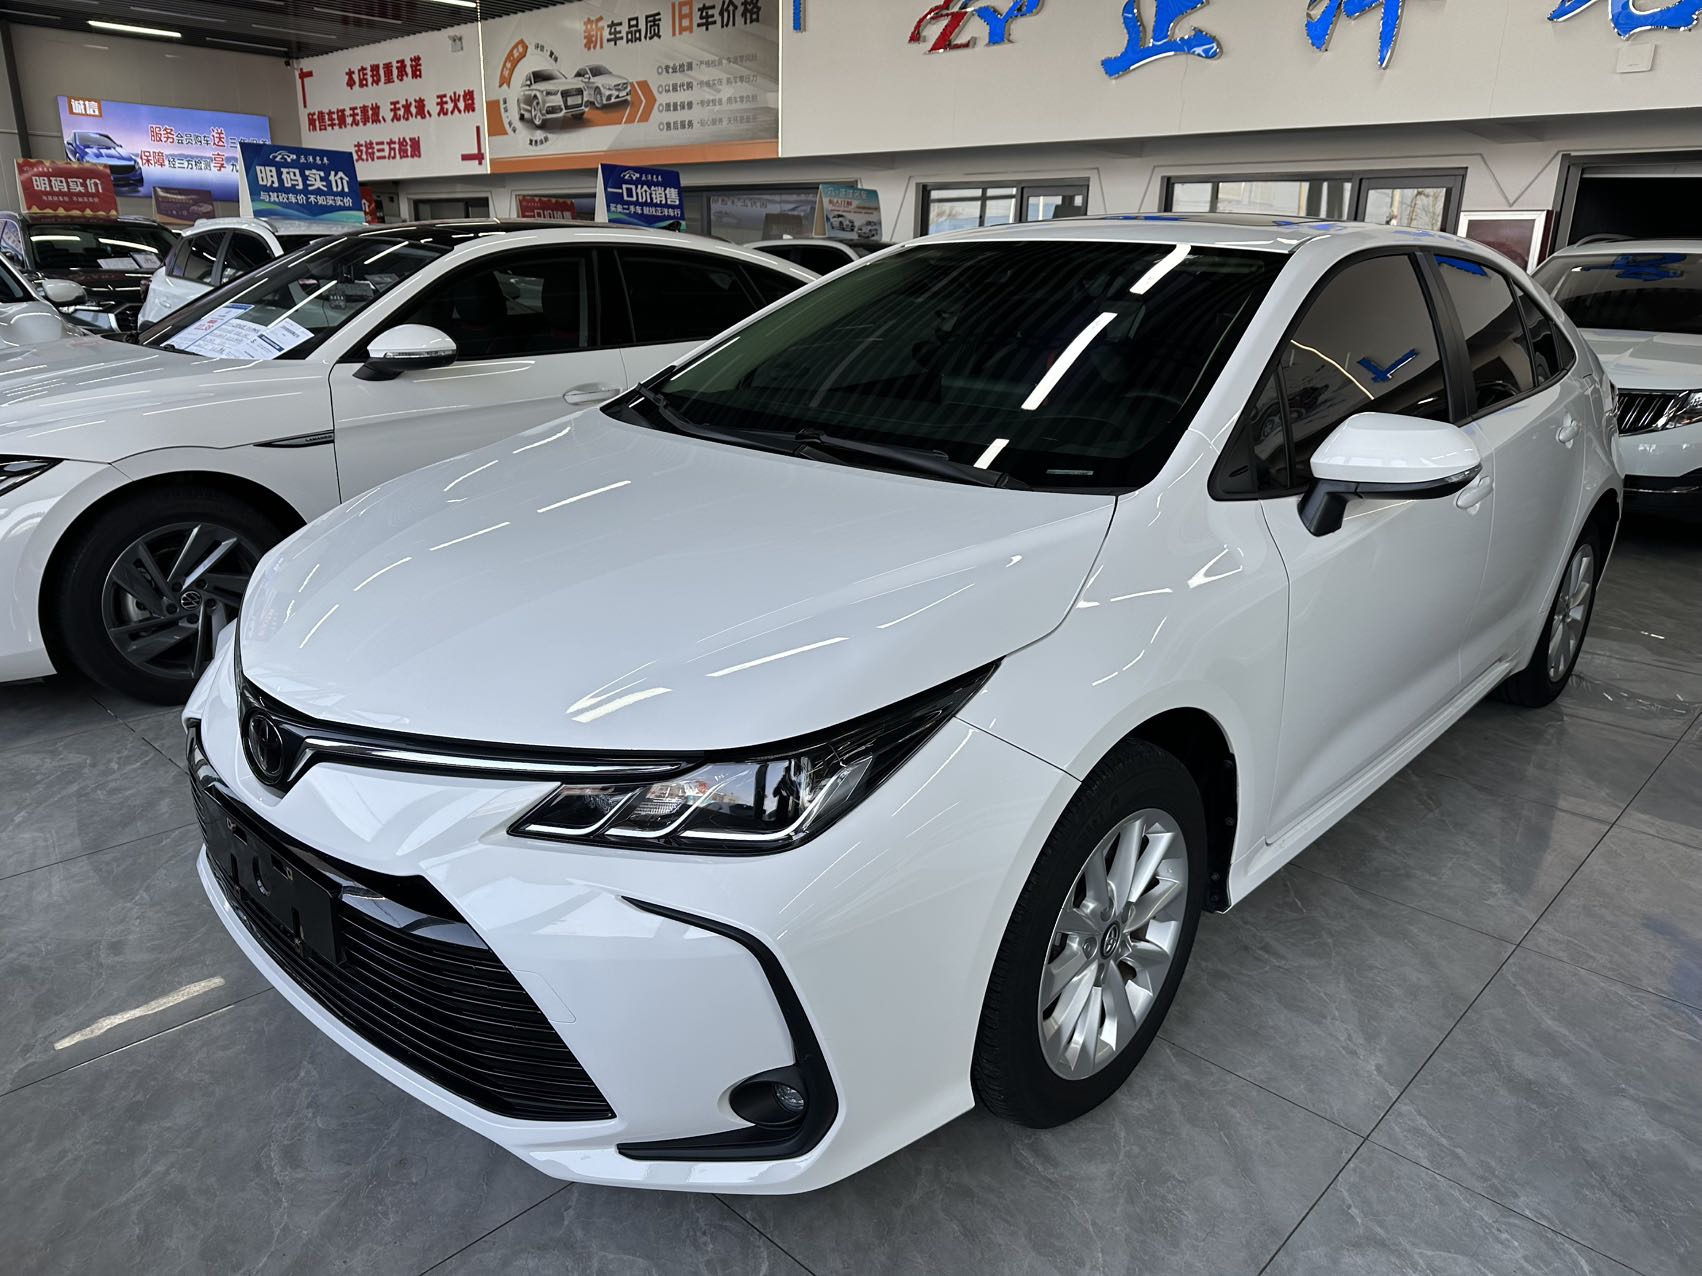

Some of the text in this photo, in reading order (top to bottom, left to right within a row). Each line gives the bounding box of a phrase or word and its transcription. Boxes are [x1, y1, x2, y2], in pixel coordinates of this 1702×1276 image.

[583, 15, 662, 51] 新车品质
[671, 0, 762, 37] 旧车价格
[345, 55, 422, 90] 本店郑重承诺
[70, 99, 100, 116] 诚信
[354, 136, 422, 163] 支持三方检测
[32, 176, 103, 193] 明码实价
[255, 166, 349, 193] 明码实价
[308, 195, 353, 207] 不如买实价
[607, 184, 680, 205] 一口价销售
